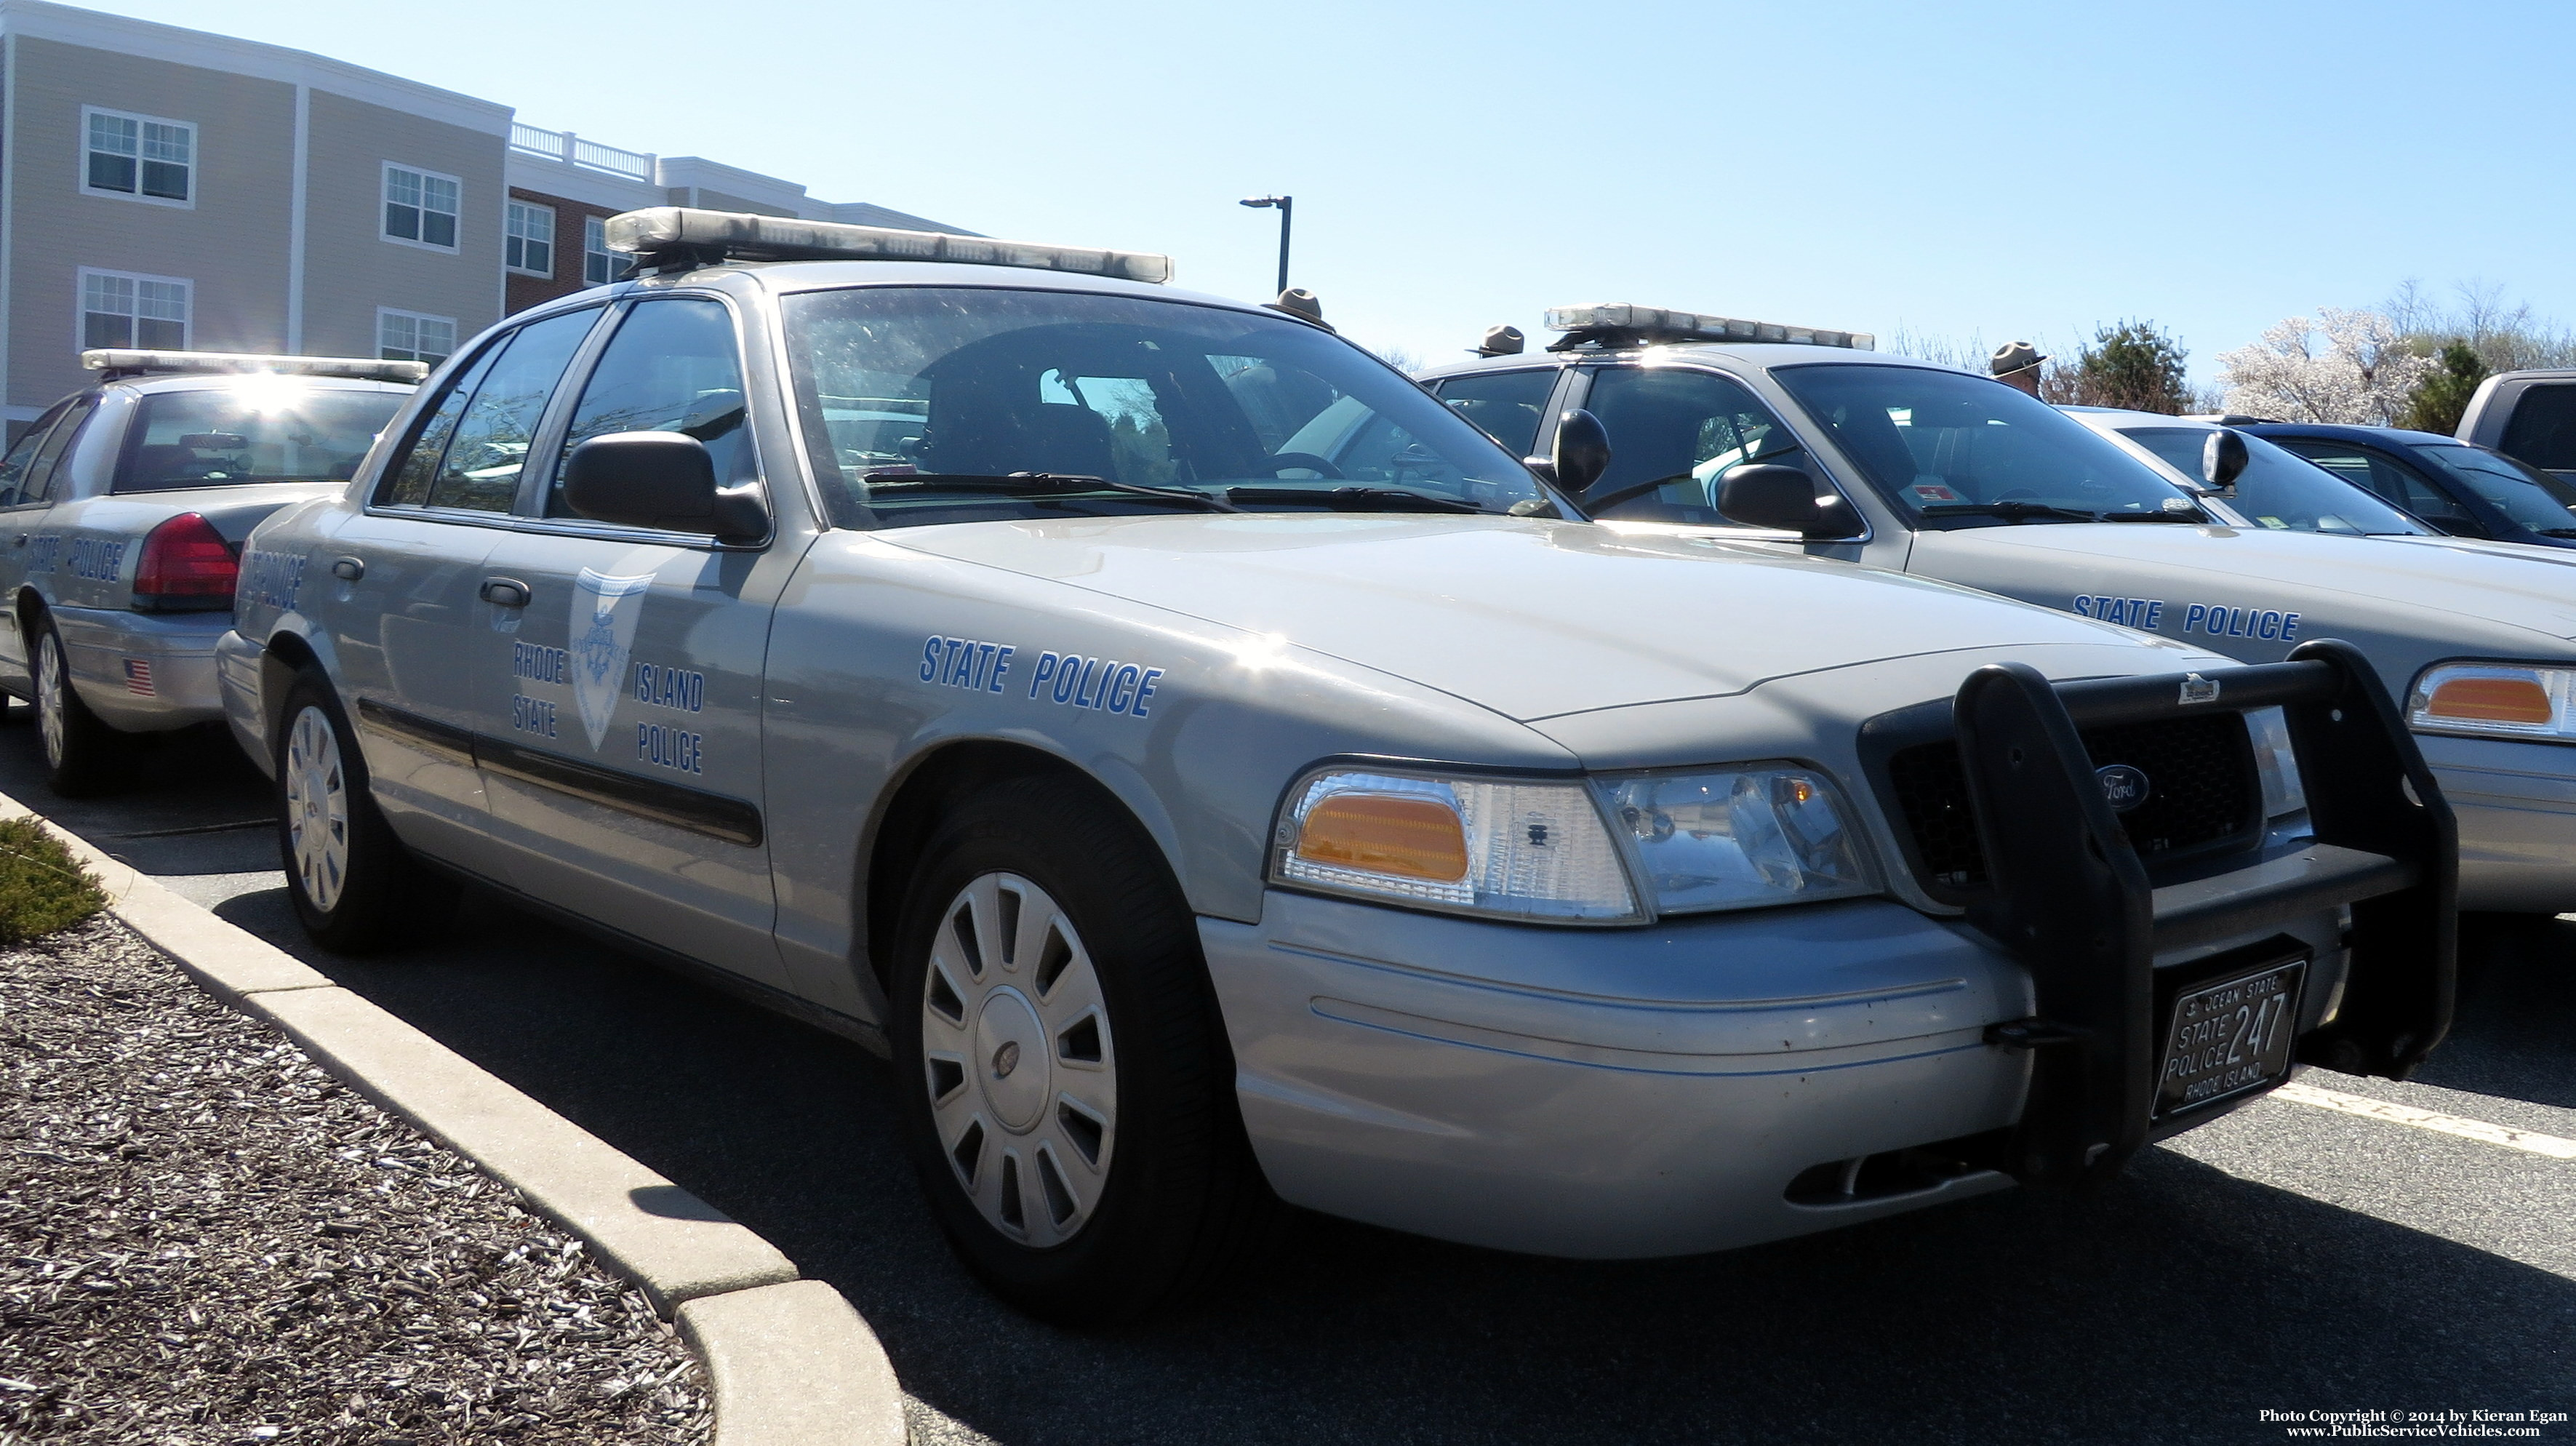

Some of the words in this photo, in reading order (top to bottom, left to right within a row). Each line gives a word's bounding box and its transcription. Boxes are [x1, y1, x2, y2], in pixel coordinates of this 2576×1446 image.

[70, 538, 123, 584] POLICE
[2072, 594, 2164, 630] STATE
[2183, 603, 2301, 642] POLICE
[513, 640, 564, 685] RHODE
[633, 662, 705, 714] ISLAND
[919, 634, 1017, 694] STATE
[1028, 650, 1166, 719] POLICE
[513, 694, 557, 740] STATE
[638, 722, 703, 776] POLICE
[2103, 775, 2136, 799] Ford
[2246, 975, 2279, 999] STATE
[2178, 1014, 2231, 1049] STATE
[2225, 993, 2286, 1065] 247
[2166, 1042, 2228, 1082] POLICE
[2184, 1074, 2218, 1101] RHODE
[2223, 1062, 2260, 1088] ISLAND
